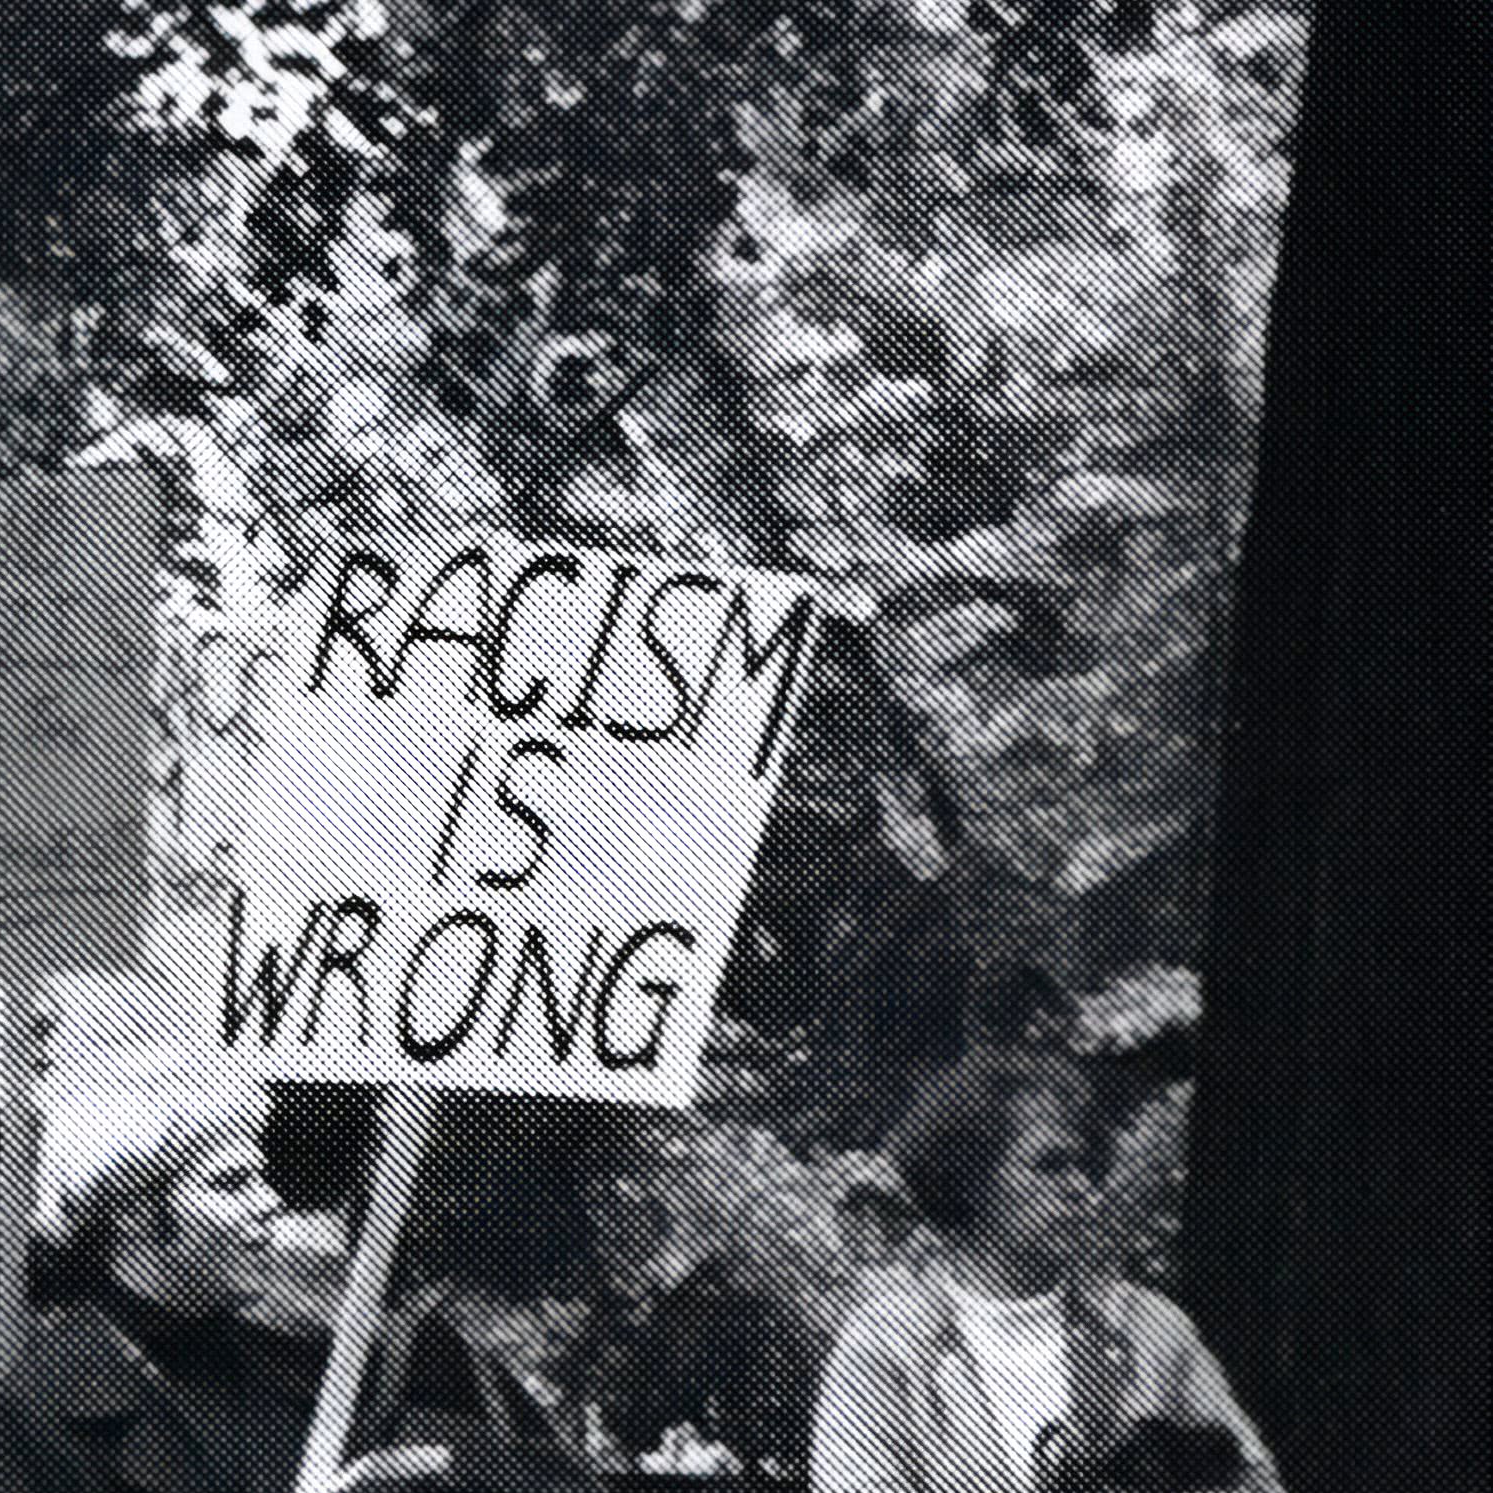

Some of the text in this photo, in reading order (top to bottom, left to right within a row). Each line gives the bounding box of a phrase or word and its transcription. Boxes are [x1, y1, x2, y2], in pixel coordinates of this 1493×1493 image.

[305, 546, 815, 781] RACISM
[429, 731, 565, 892] IS
[220, 885, 697, 1071] WRONG
